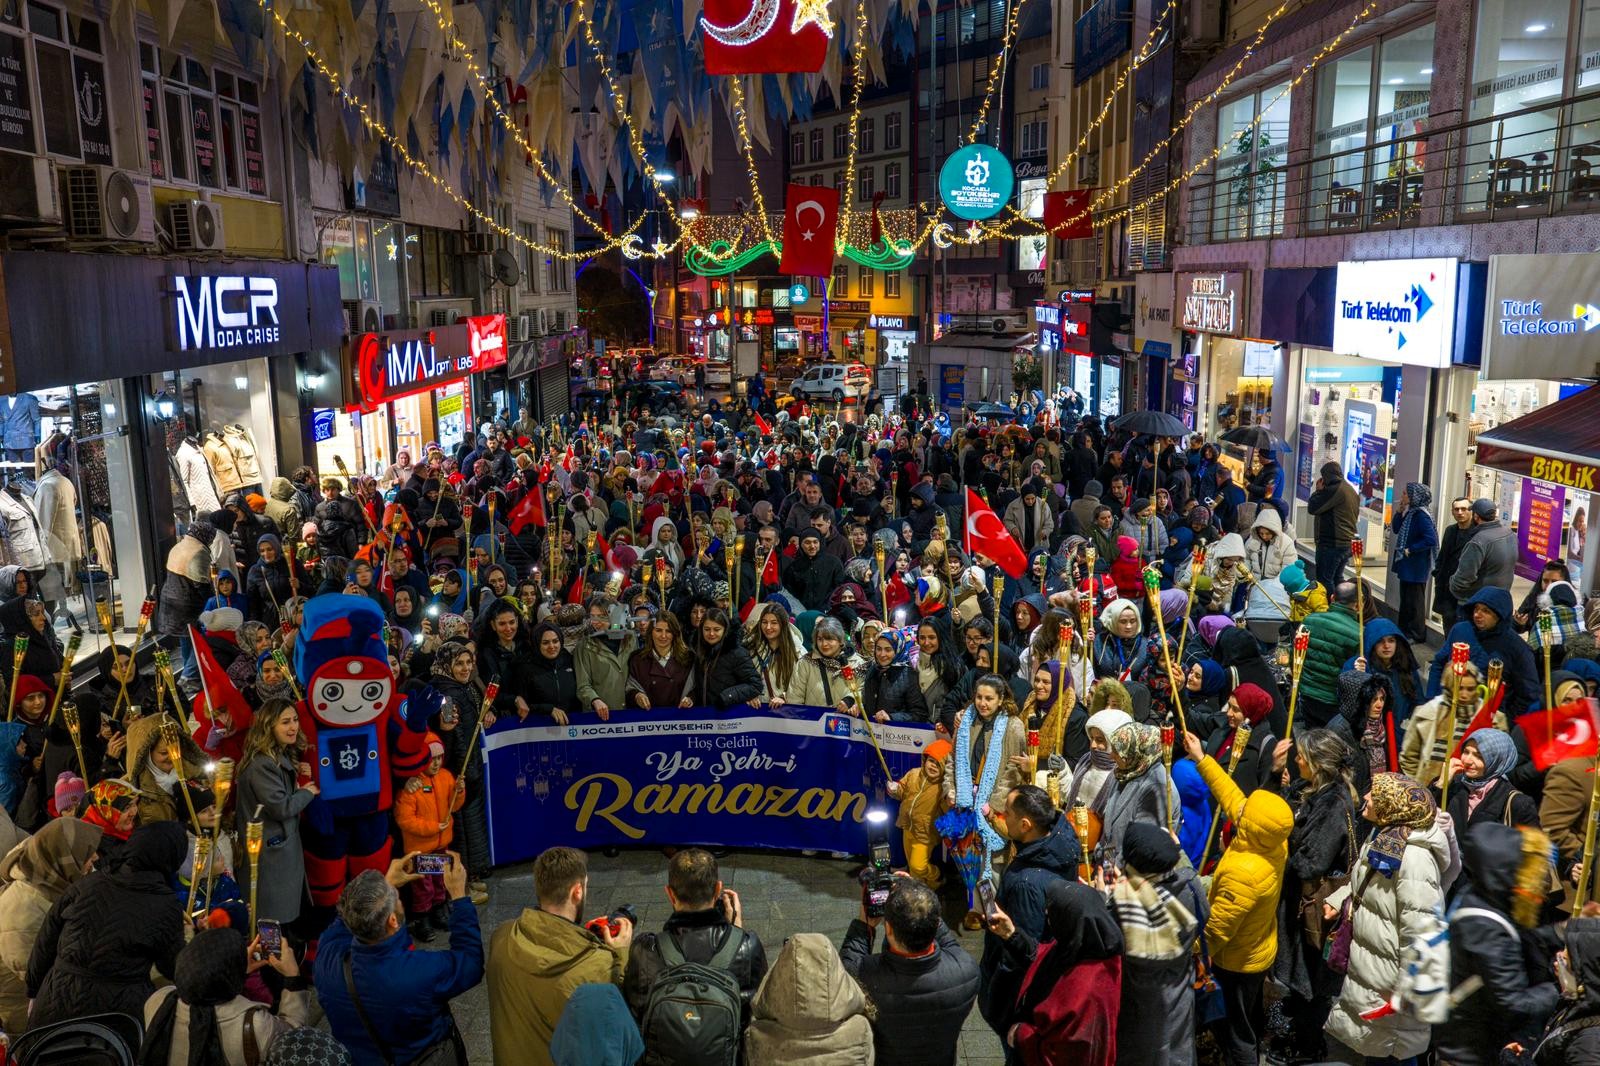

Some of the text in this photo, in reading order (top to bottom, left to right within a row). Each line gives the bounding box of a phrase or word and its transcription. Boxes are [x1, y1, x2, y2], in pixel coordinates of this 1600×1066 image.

[1586, 52, 1600, 69] DAİ
[1493, 77, 1515, 92] KAHVECİ
[1517, 73, 1535, 86] ASLAN
[1537, 64, 1558, 81] EFENDİ
[1148, 308, 1156, 321] AK
[1341, 301, 1411, 323] Türk Telekom
[1502, 300, 1541, 317] Türk
[246, 326, 279, 344] CRISE
[1501, 319, 1577, 336] Telekom
[688, 735, 757, 751] Hoş Geldin
[645, 749, 797, 783] Ya Şehr-i
[564, 772, 867, 840] Ramazan
